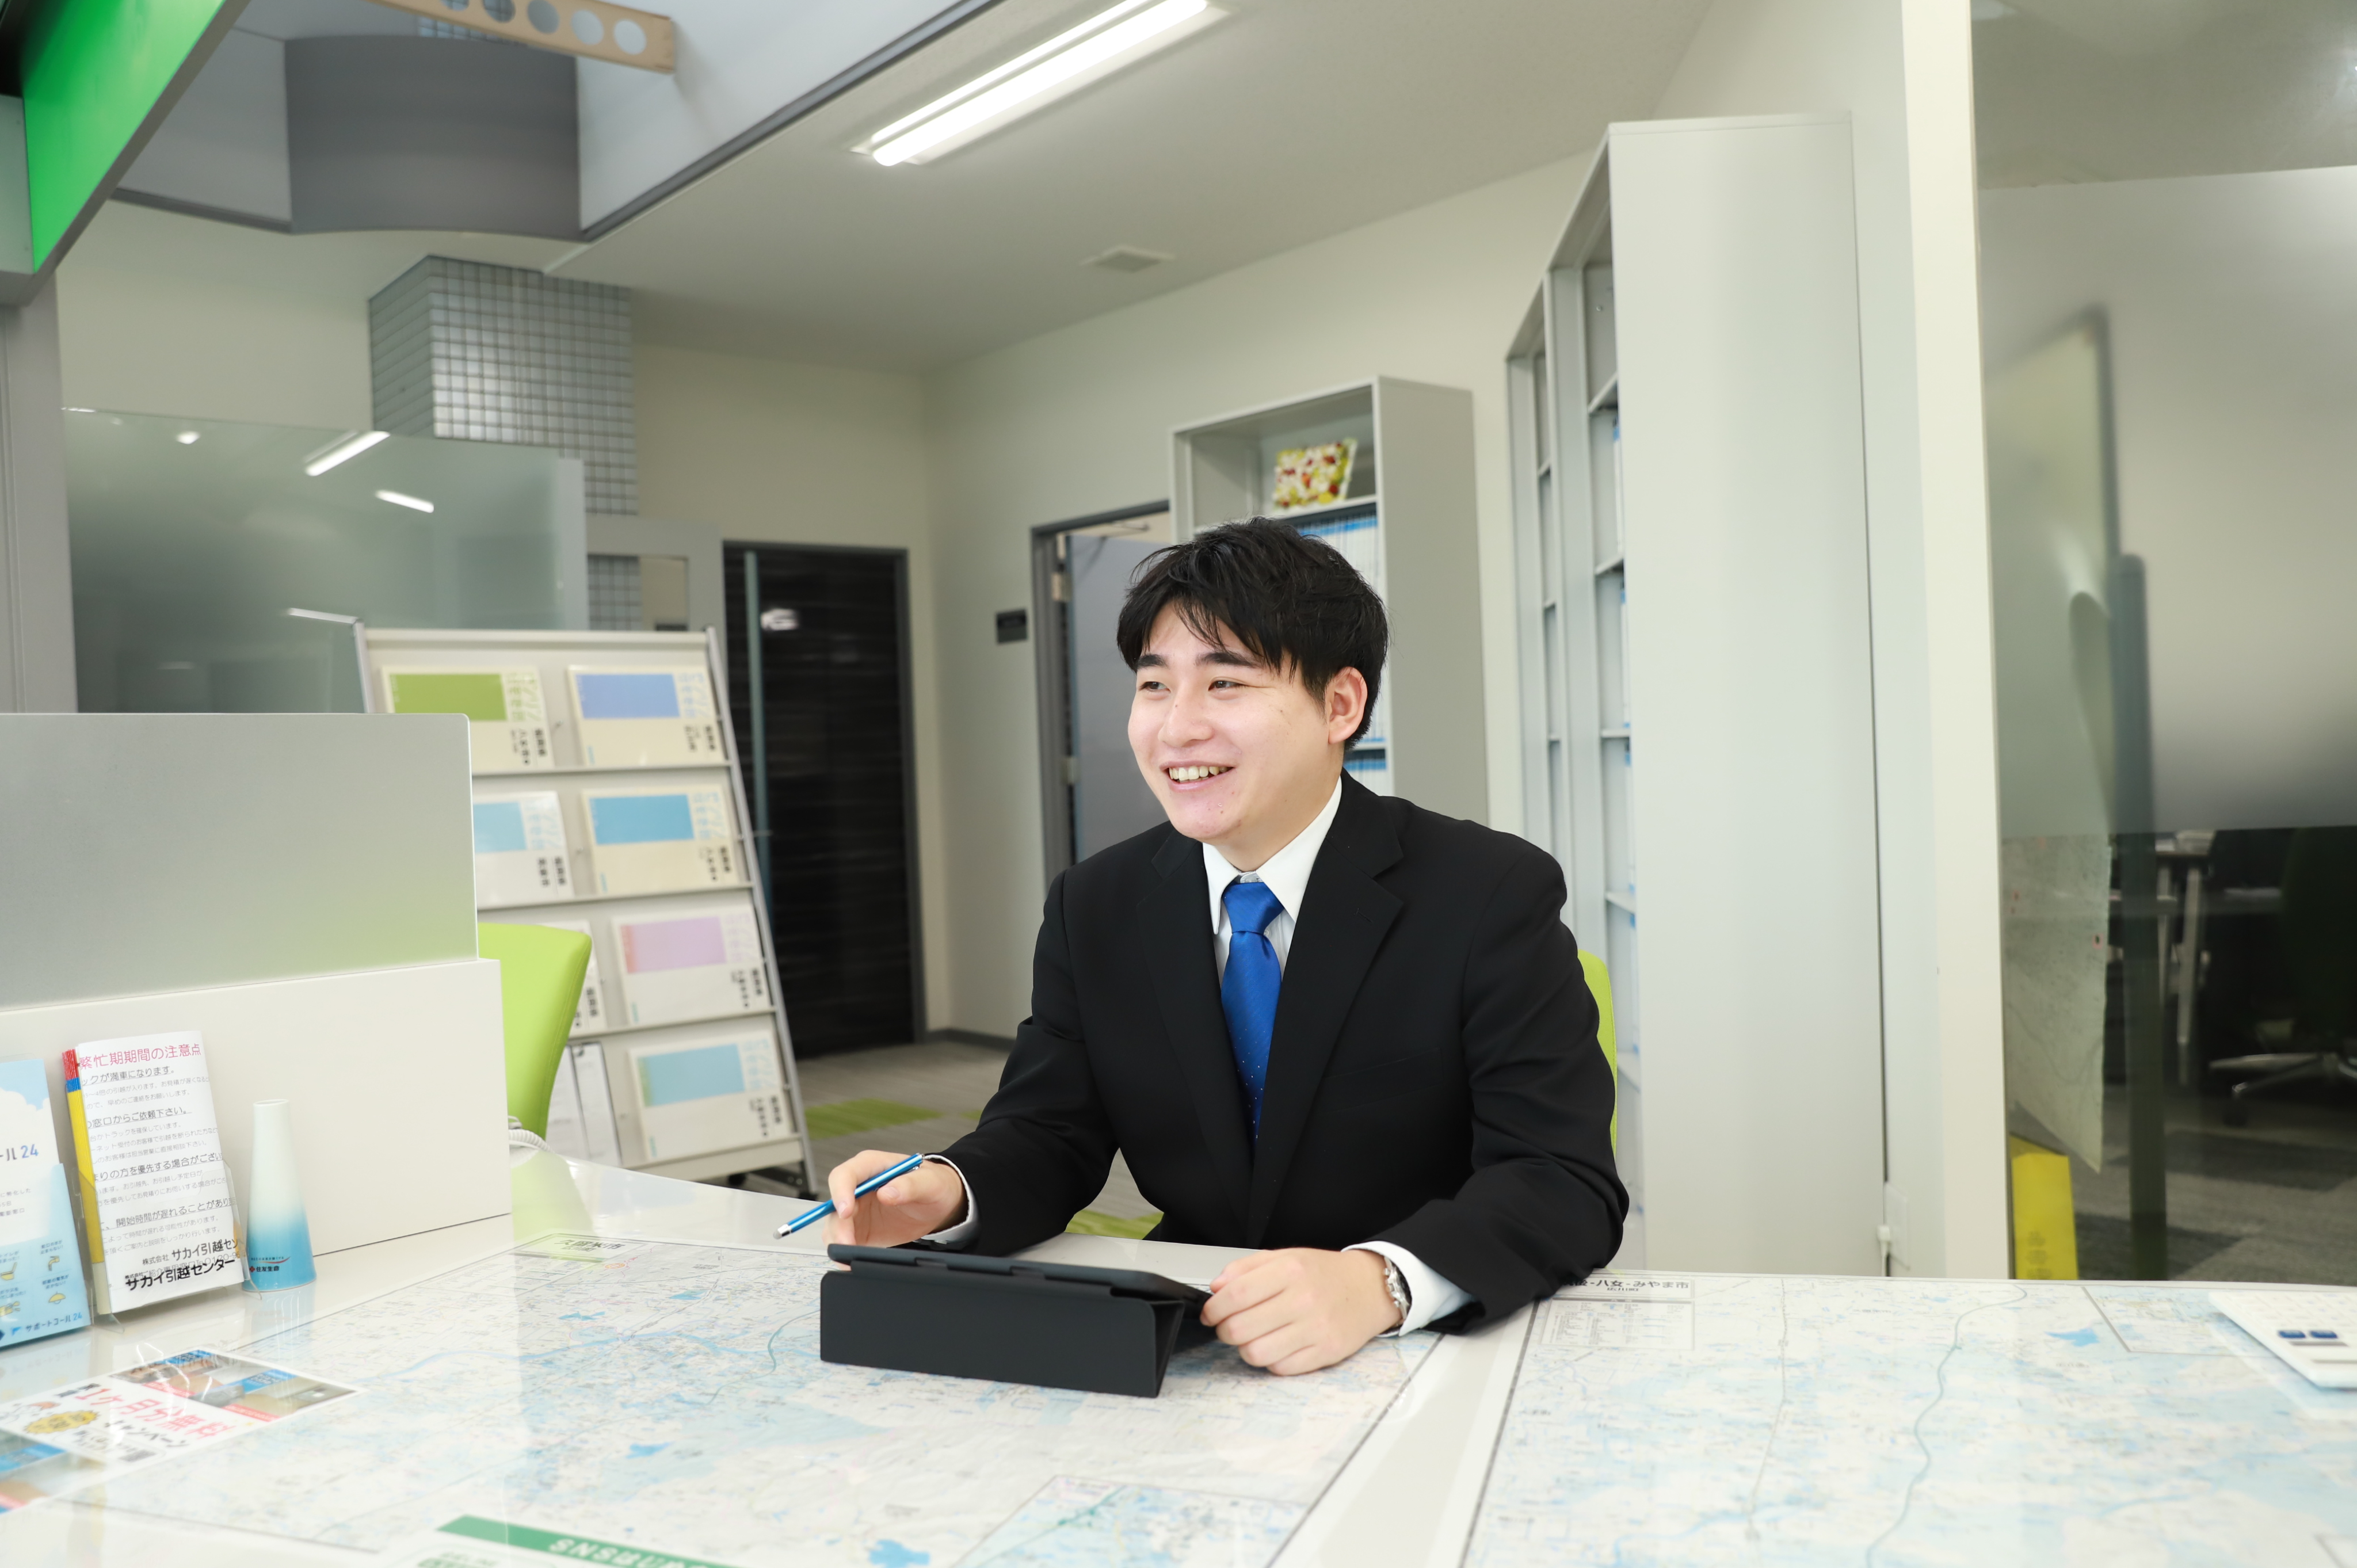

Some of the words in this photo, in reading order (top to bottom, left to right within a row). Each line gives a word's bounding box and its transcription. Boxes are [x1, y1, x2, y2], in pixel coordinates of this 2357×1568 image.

[79, 1044, 201, 1070] 繁忙期期間の注意点
[21, 1144, 39, 1159] 24
[94, 1153, 223, 1180] まりの方を優先する場合がござい
[142, 1254, 169, 1265] 株式会社
[125, 1258, 235, 1291] サカイ引越センター
[25, 1315, 71, 1332] サポートコール
[73, 1312, 83, 1321] 24
